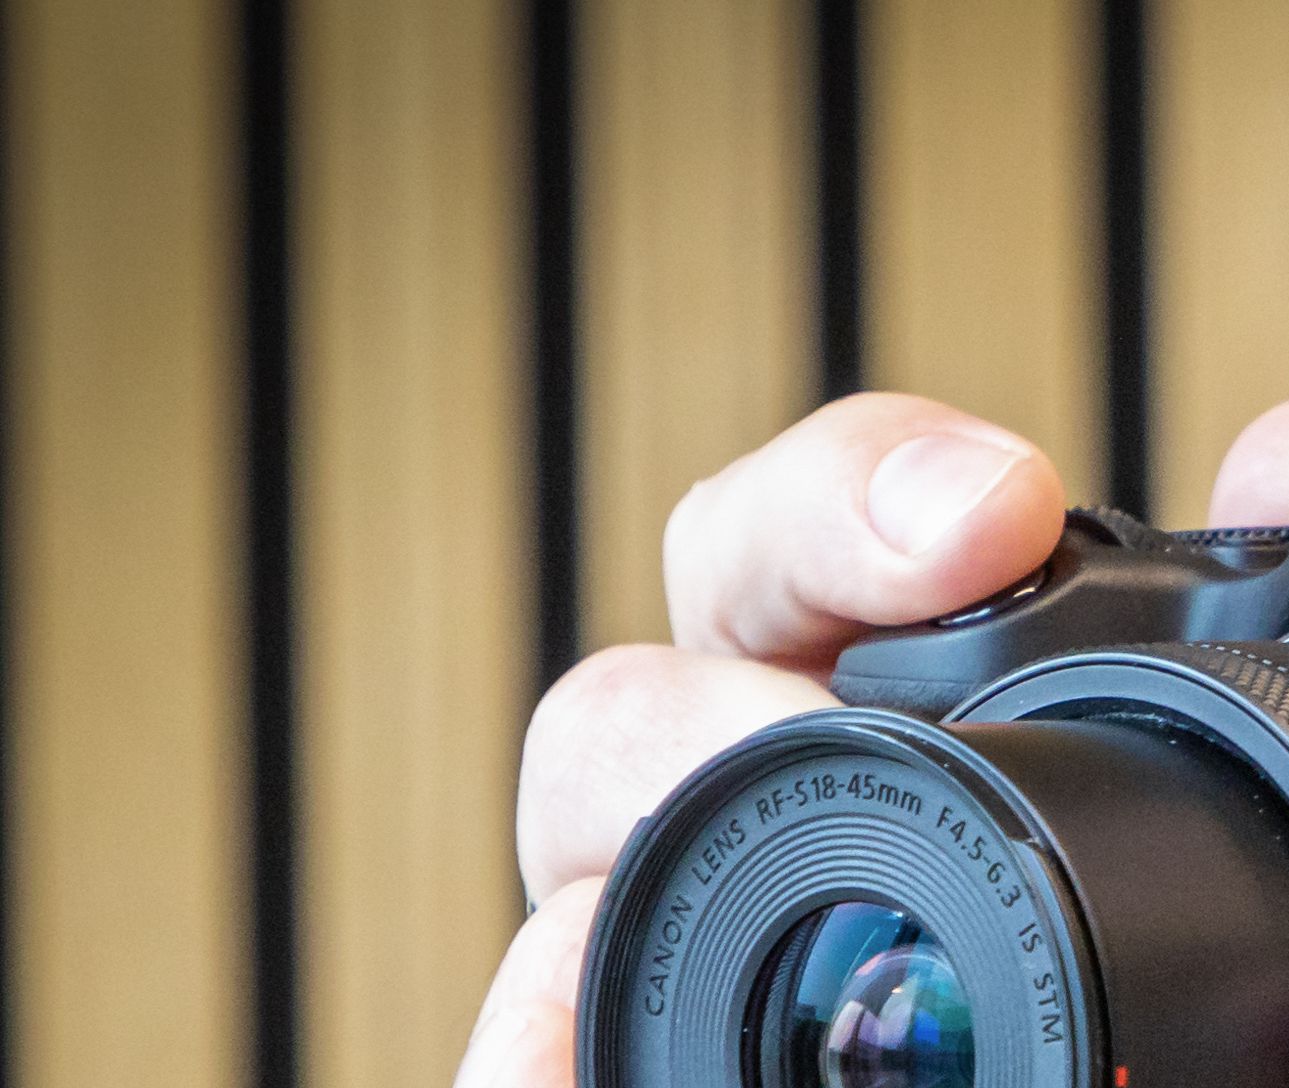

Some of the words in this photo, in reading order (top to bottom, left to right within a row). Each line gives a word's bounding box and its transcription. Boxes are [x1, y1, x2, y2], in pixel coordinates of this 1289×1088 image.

[646, 895, 693, 1016] CANON
[692, 819, 746, 885] LENS
[755, 771, 923, 825] RF-S18-45mm
[937, 806, 1022, 908] F4.5-6.3
[1019, 923, 1043, 953] IS
[1034, 973, 1064, 1044] STM
